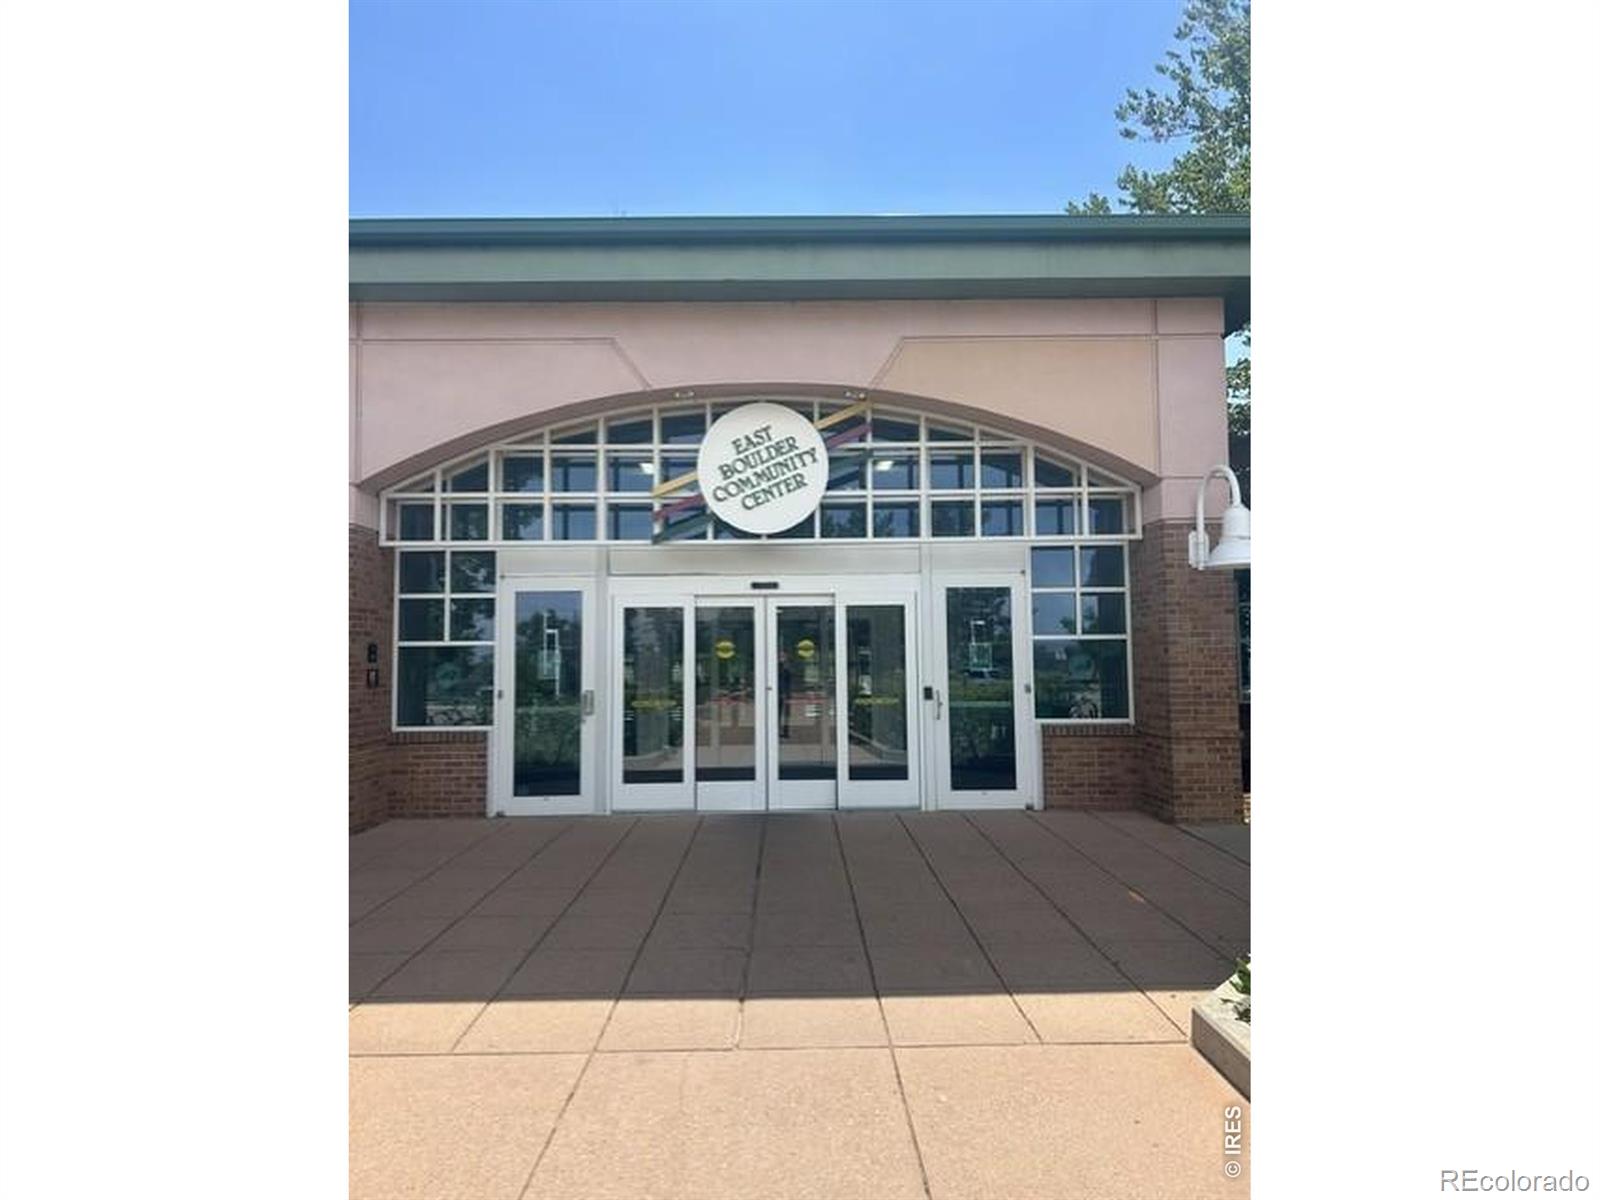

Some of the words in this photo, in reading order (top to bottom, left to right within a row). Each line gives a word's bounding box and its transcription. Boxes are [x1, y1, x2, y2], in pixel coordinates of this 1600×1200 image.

[718, 436, 799, 480] BOULDER
[732, 425, 774, 455] EAST
[713, 447, 818, 502] COMMUNITY
[741, 473, 808, 510] CENTER
